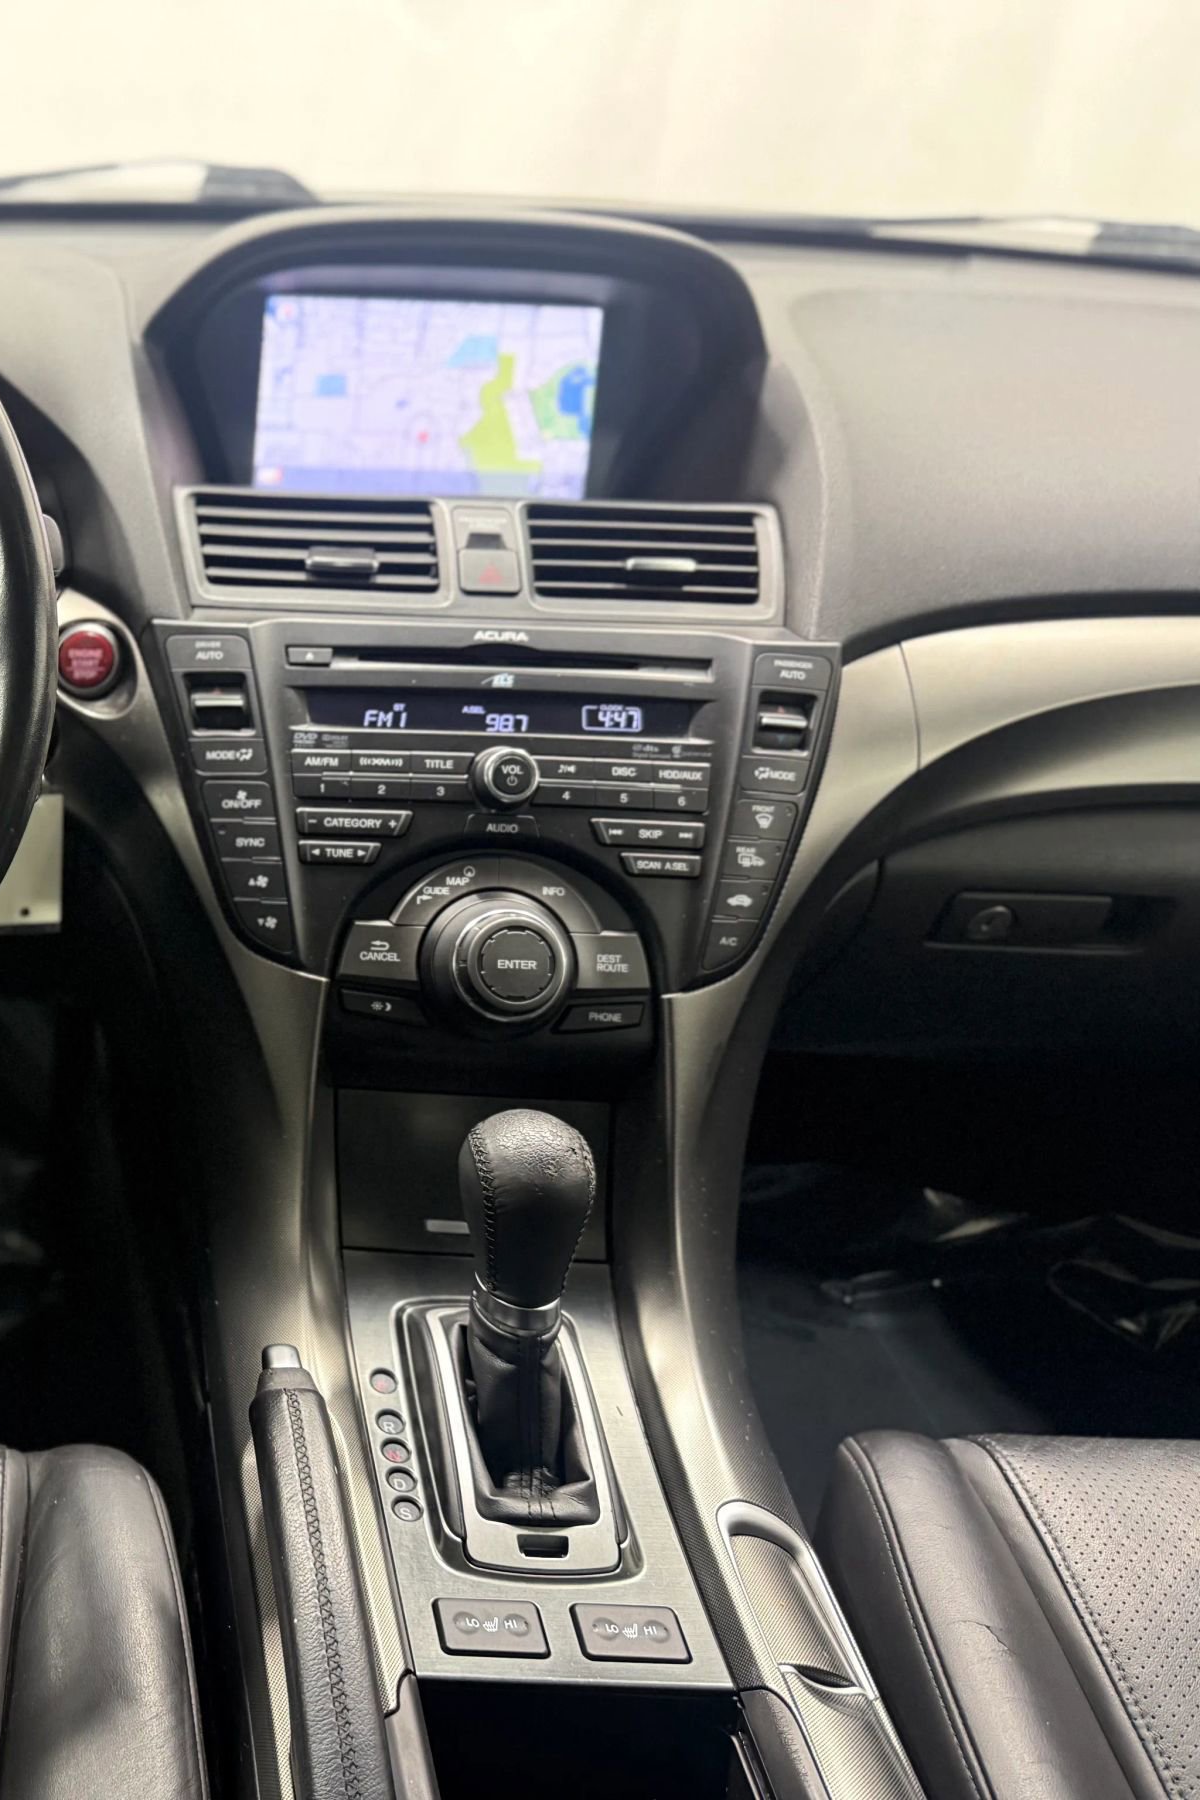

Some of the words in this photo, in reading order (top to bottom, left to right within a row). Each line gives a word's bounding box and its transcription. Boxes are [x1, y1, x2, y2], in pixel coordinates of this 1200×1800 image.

[473, 630, 529, 642] ACURA
[195, 651, 224, 660] AUTO
[779, 670, 806, 680] AUTO
[597, 710, 638, 729] 4:47
[205, 750, 236, 760] MODE
[304, 757, 339, 767] AM/FM
[424, 759, 454, 769] TITLE
[501, 765, 524, 775] VOL
[611, 767, 637, 777] DISC
[658, 769, 703, 781] HDD/AUX
[769, 771, 796, 781] MODE
[319, 783, 326, 793] 1
[377, 785, 387, 795] 2
[436, 786, 445, 796] 3
[562, 790, 571, 800] 4
[620, 793, 628, 803] 5
[221, 798, 262, 809] ON/OFF
[677, 796, 686, 806] 6
[324, 818, 382, 829] CATEGORY
[486, 823, 519, 834] AUDIO
[638, 829, 663, 839] SKIP
[235, 837, 265, 848] SYNC
[325, 848, 353, 858] TUNE
[637, 860, 661, 870] SCAN
[446, 876, 469, 886] MAP
[423, 886, 450, 896] GUIDE
[542, 886, 566, 897] INFO
[719, 936, 738, 946] A/C
[359, 951, 401, 962] CANCEL
[596, 954, 622, 963] DEST
[497, 959, 537, 970] ENTER
[596, 963, 629, 973] ROUTE
[588, 1012, 623, 1023] PHONE
[383, 1421, 396, 1434] R
[393, 1478, 406, 1491] D
[400, 1507, 412, 1520] S
[504, 1619, 518, 1629] HI
[643, 1626, 657, 1635] HI
